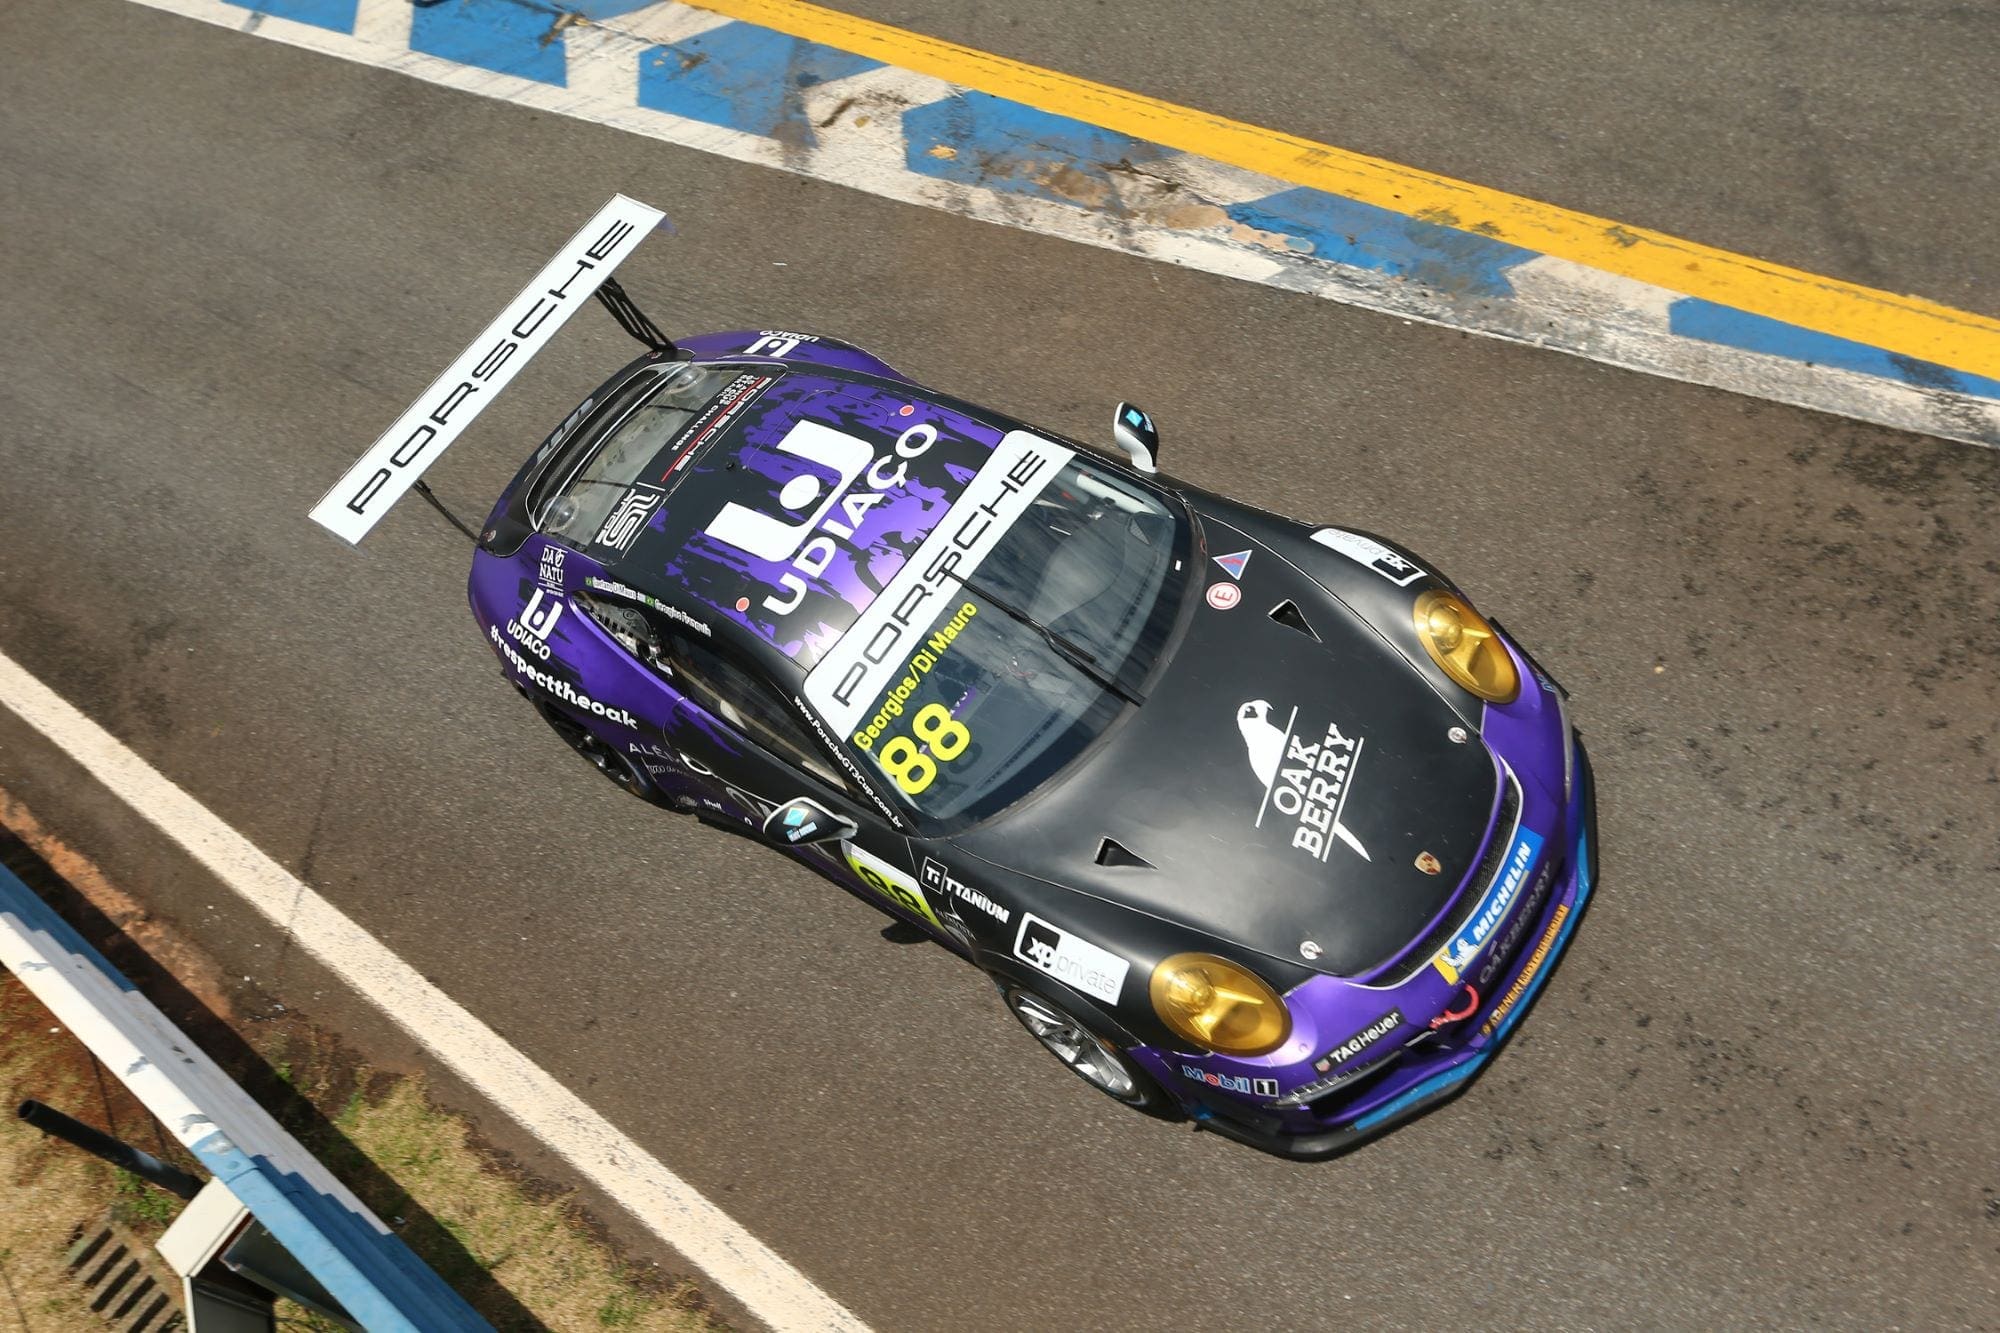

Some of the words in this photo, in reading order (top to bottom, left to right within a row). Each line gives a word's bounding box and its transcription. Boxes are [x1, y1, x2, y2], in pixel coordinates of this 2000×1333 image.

[346, 219, 635, 515] PORSCHE
[671, 404, 719, 451] CHALLENGE
[539, 562, 564, 583] NATU
[831, 449, 1047, 707] PORSCHE
[927, 601, 978, 655] Mauro
[490, 624, 639, 731] #respecttheoak
[794, 695, 904, 829] www.PorscheGT3Cup.com.br
[879, 703, 971, 794] 88
[1273, 734, 1321, 815] OAK
[1291, 722, 1356, 859] BERRY
[1471, 841, 1532, 942] MICHELIN
[1027, 937, 1059, 969] xp
[1056, 953, 1118, 996] private
[1181, 1065, 1251, 1094] Mobil
